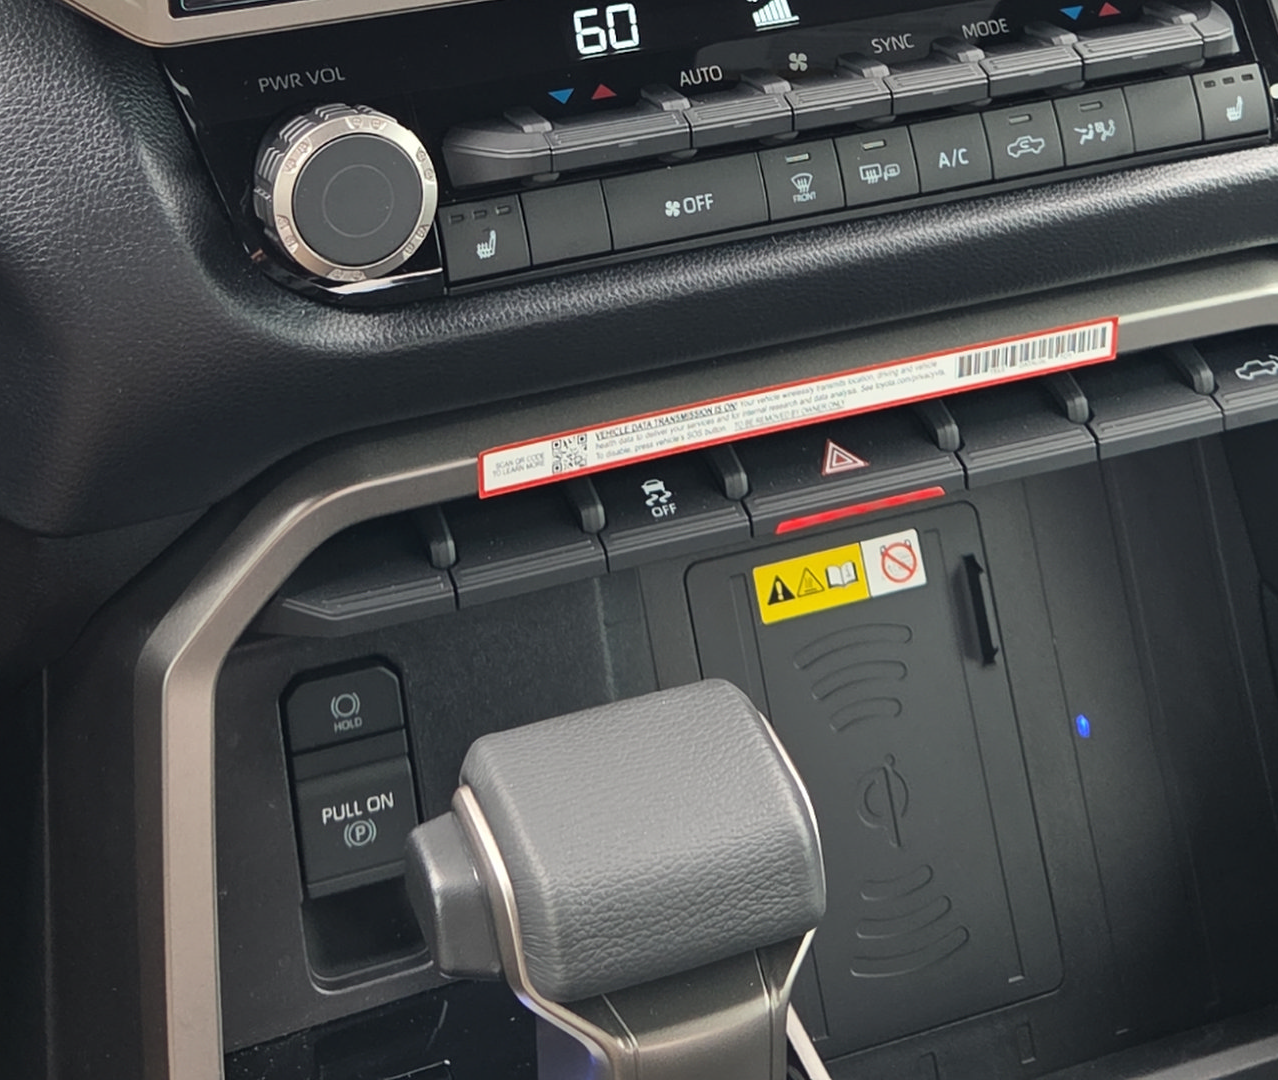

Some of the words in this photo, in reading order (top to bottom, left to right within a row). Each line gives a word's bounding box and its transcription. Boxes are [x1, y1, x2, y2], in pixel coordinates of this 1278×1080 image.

[574, 3, 639, 54] 60
[962, 19, 1008, 39] MODE
[872, 34, 914, 53] SYNC
[259, 73, 303, 92] PWR
[306, 67, 345, 84] VOL
[681, 65, 722, 86] AUTO
[939, 148, 969, 168] A/C
[683, 194, 713, 213] OFF
[650, 502, 676, 517] OFF
[334, 716, 362, 732] HOLD
[322, 801, 362, 825] PULL
[367, 792, 393, 812] ON
